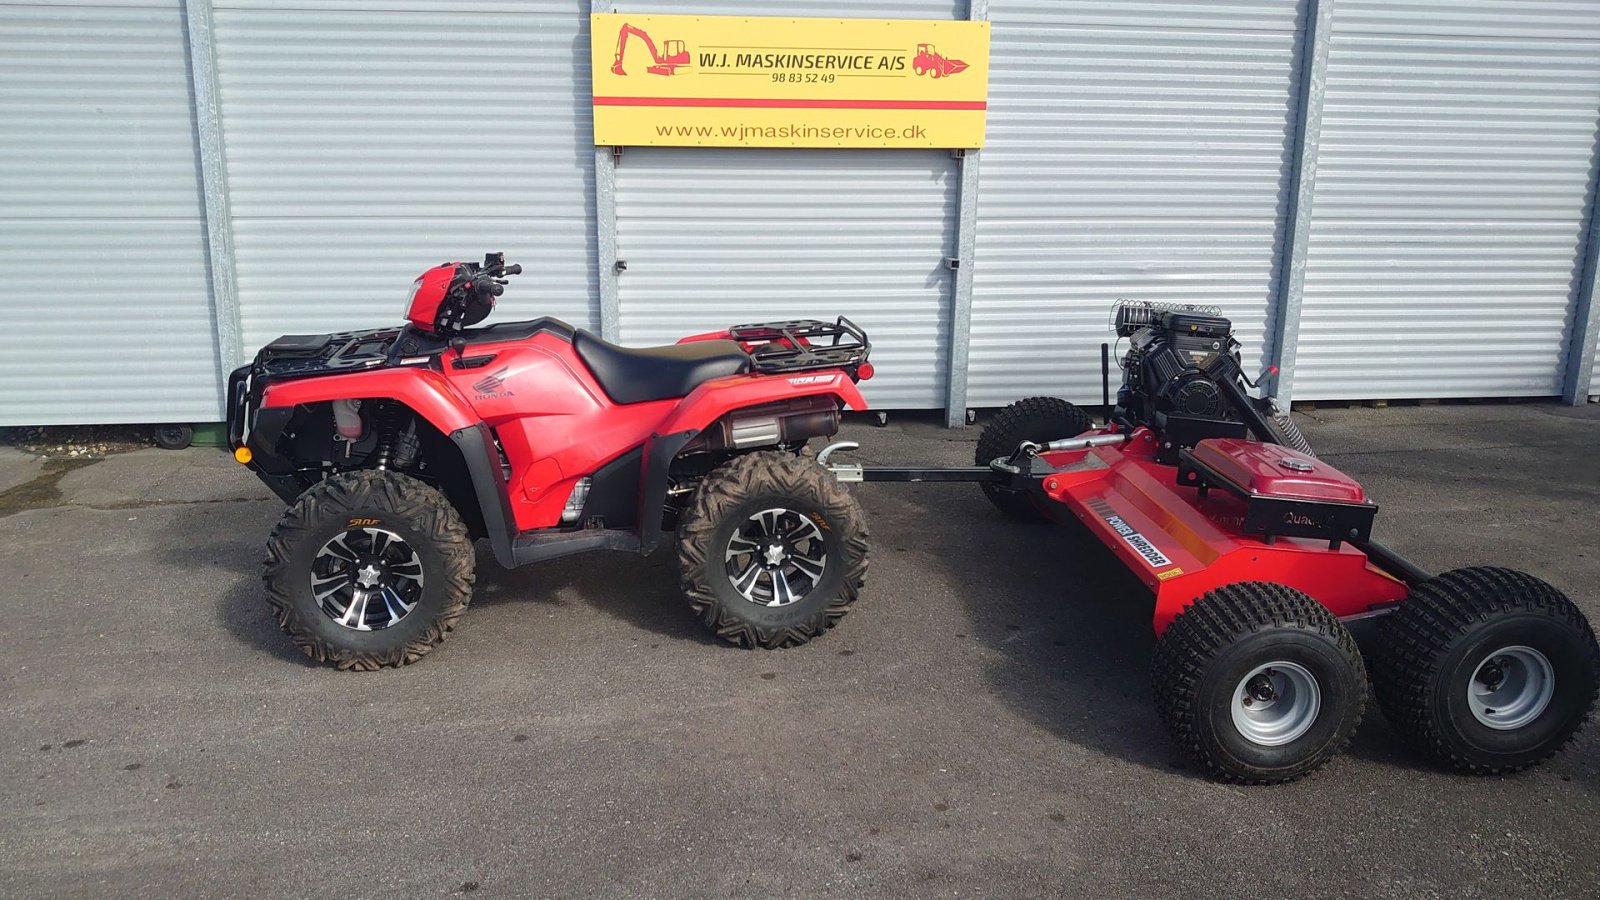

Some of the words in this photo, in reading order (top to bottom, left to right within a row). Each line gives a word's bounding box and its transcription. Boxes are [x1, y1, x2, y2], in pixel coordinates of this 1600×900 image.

[699, 53, 731, 68] W.J.
[735, 53, 874, 70] MASKINSERVICE
[877, 56, 906, 71] A/S
[771, 73, 786, 83] 98
[788, 73, 803, 83] 83
[804, 74, 819, 83] 52
[820, 74, 835, 83] 49
[655, 123, 927, 141] www.wjmaskinservice.dk
[474, 391, 514, 400] HONDA
[1105, 515, 1134, 536] POWER
[1126, 535, 1167, 566] SHREDDER
